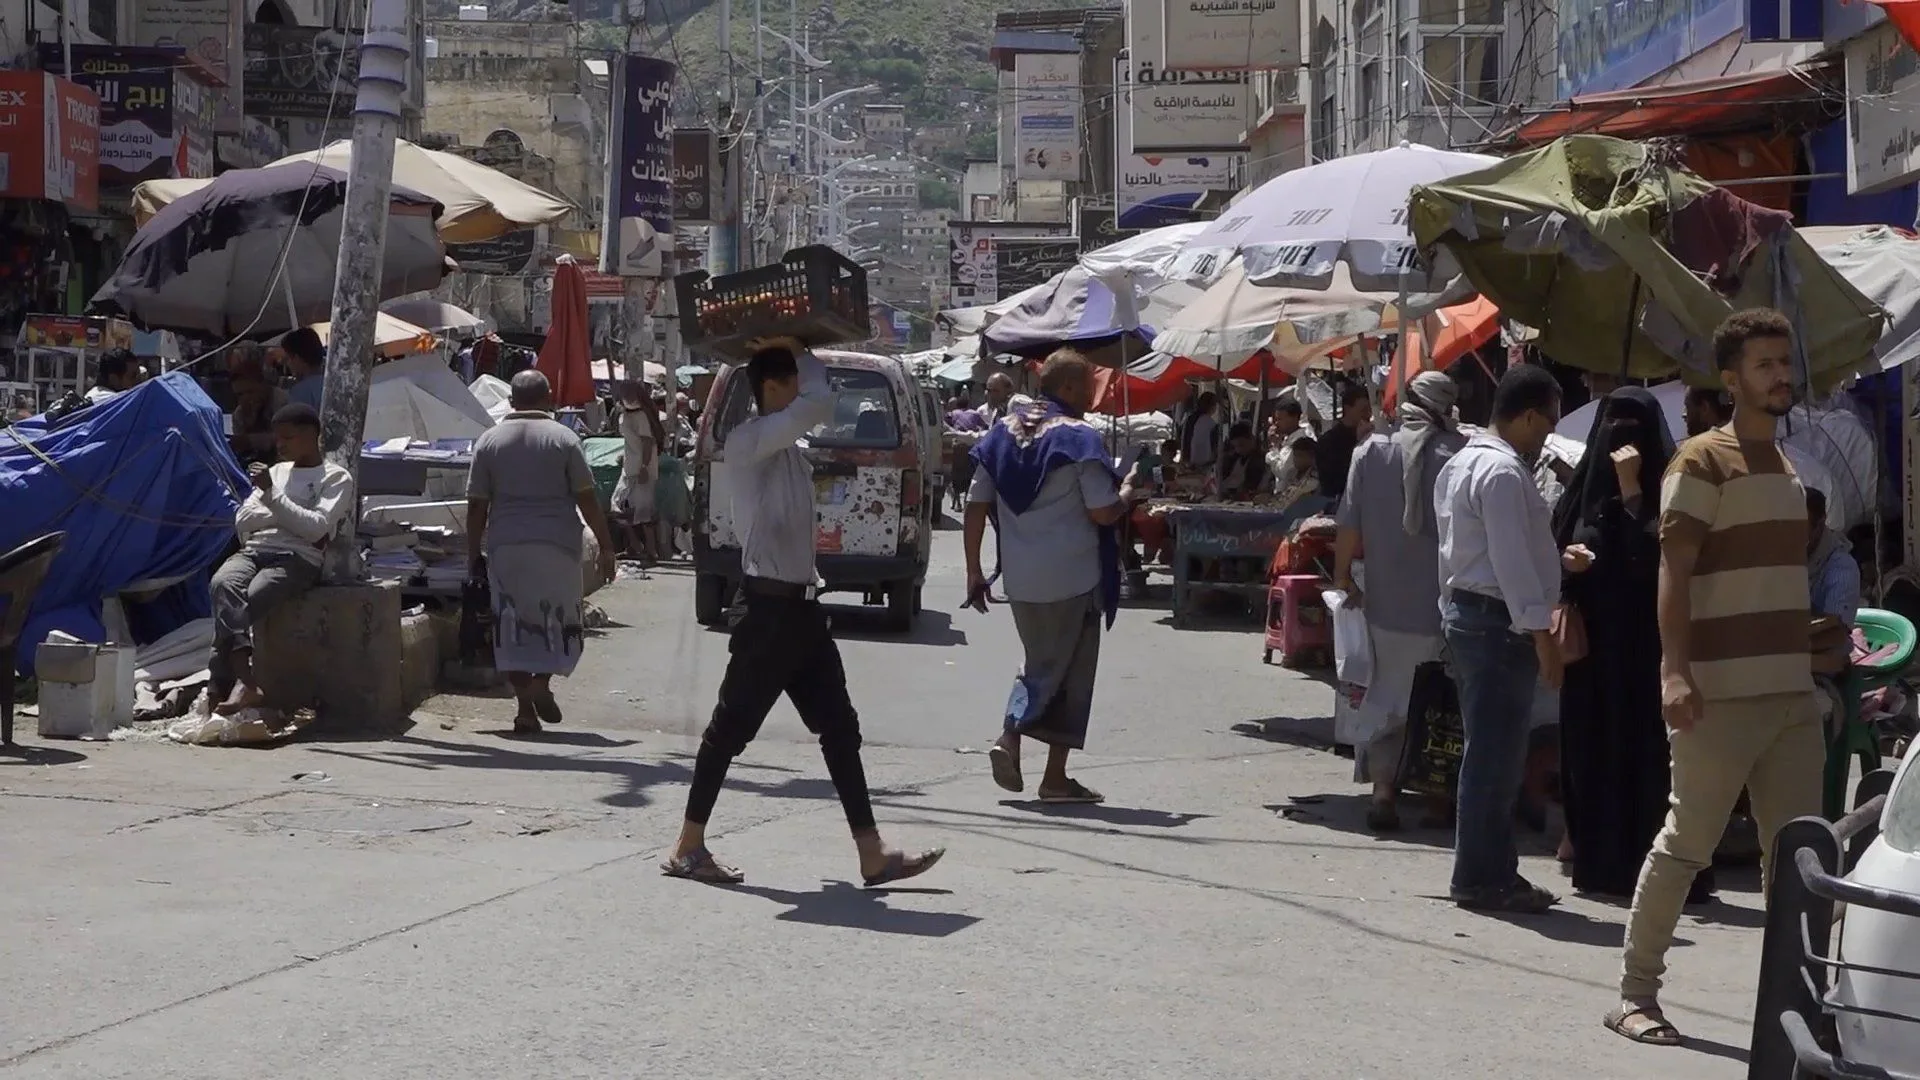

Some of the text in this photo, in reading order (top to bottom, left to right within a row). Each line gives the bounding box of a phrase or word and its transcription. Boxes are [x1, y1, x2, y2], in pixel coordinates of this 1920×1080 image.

[125, 85, 165, 110] برج
[1153, 95, 1191, 111] الراقية
[66, 96, 99, 129] TRONEX
